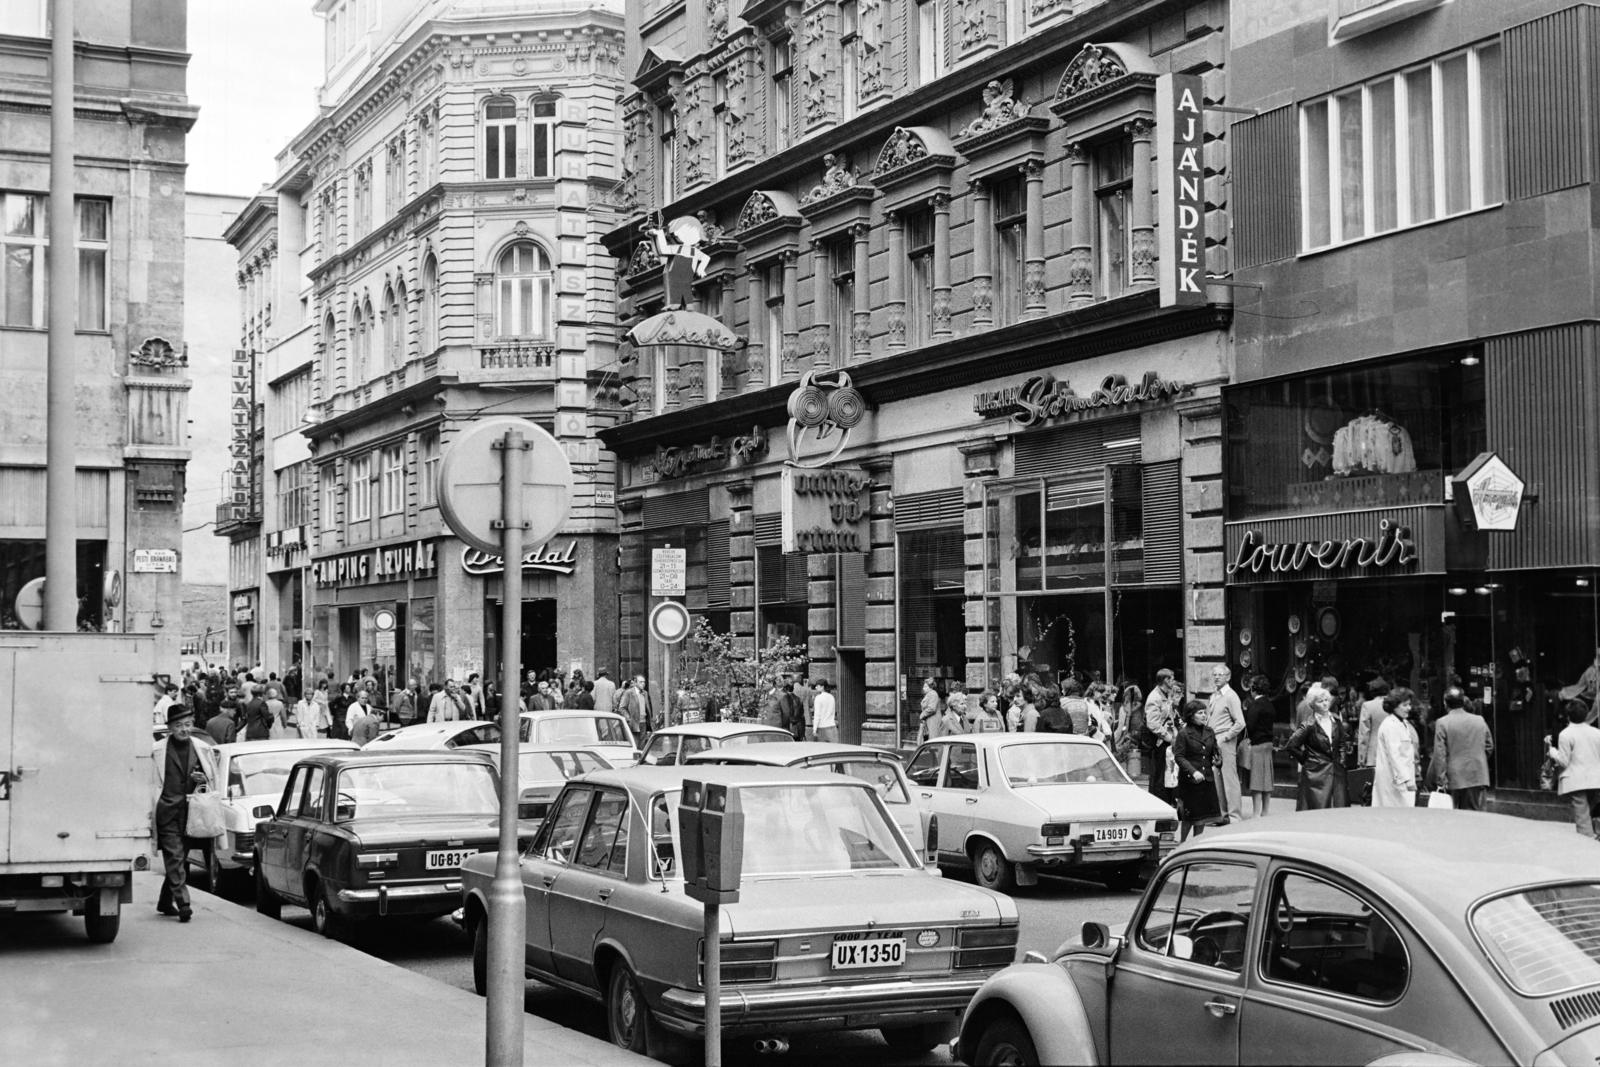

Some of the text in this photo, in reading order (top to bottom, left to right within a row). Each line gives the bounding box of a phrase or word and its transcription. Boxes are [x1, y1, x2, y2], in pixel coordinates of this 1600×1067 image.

[1177, 88, 1201, 292] AJÁNDÉK
[234, 350, 247, 518] DIVATSZALON
[312, 555, 369, 583] CAMPING
[1227, 518, 1412, 574] Souvenir
[834, 932, 861, 940] GOOD
